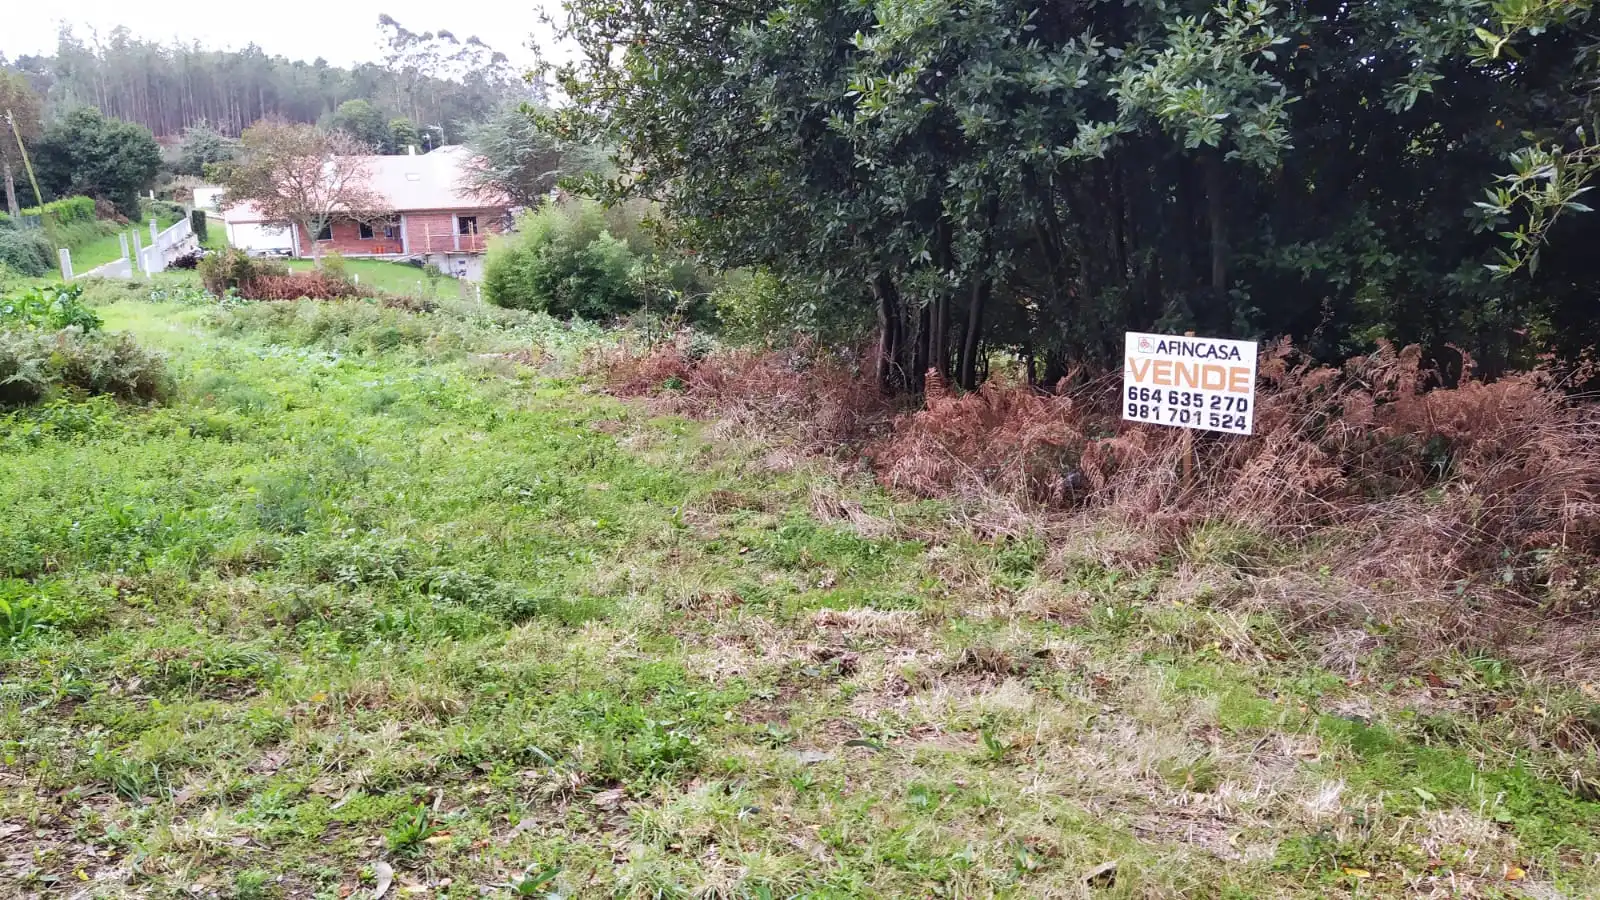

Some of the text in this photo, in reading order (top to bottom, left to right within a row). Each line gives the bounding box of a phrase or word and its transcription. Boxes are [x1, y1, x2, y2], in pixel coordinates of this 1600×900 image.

[1156, 340, 1242, 361] AFINCASA
[1128, 357, 1251, 393] VENDE
[1128, 386, 1248, 412] 664 635 270
[1128, 403, 1246, 430] 981 701 524
